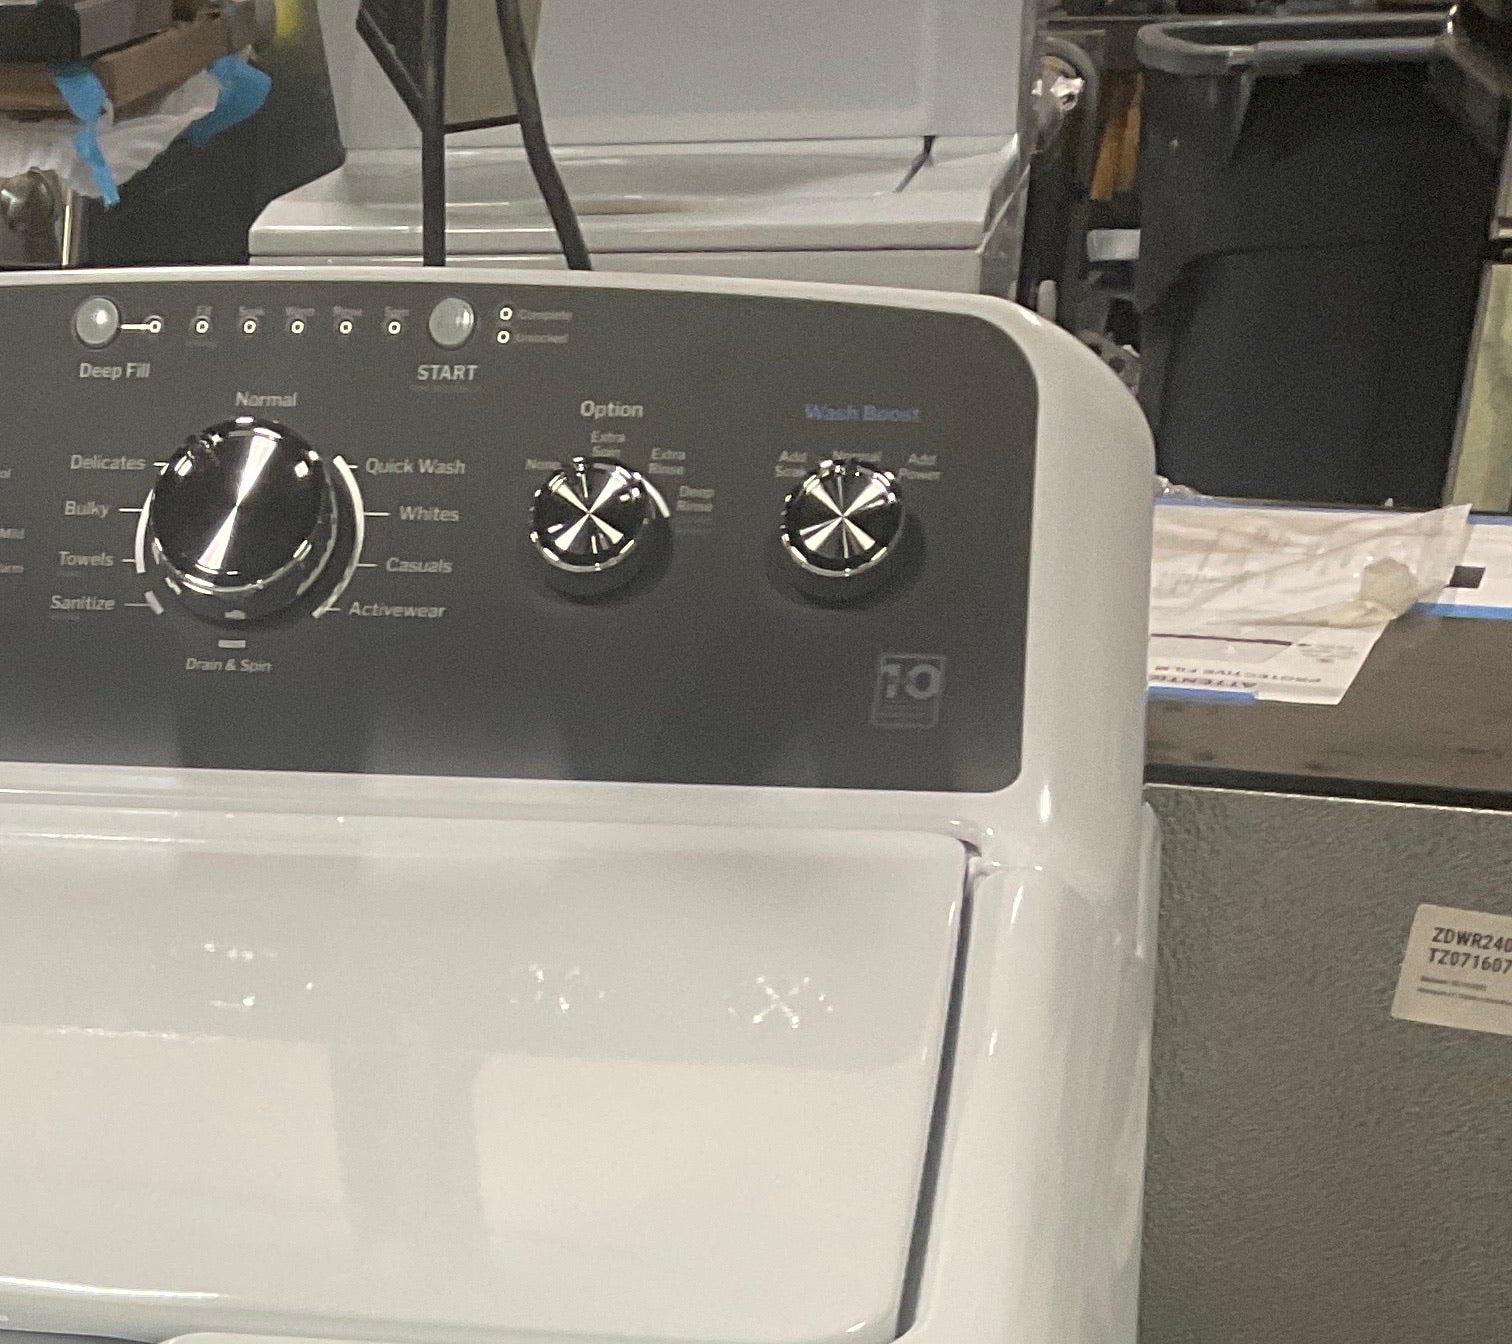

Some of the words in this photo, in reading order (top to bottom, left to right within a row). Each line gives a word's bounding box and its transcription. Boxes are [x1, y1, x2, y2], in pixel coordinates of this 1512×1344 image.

[79, 363, 122, 380] Deep
[125, 362, 151, 378] Fill
[417, 364, 479, 380] START
[235, 391, 297, 408] Normal
[580, 400, 644, 419] Option
[805, 404, 859, 421] Wash
[70, 455, 146, 471] Delicates
[366, 457, 414, 474] Quick
[418, 458, 466, 474] Wash
[64, 501, 110, 518] Bulky
[399, 506, 460, 522] Whites
[59, 551, 114, 567] Towels
[385, 557, 453, 573] Casuals
[50, 595, 116, 611] Sanitize
[348, 602, 446, 618] Activewear
[185, 657, 222, 672] Drain
[225, 658, 237, 672] &
[240, 658, 273, 673] Spin
